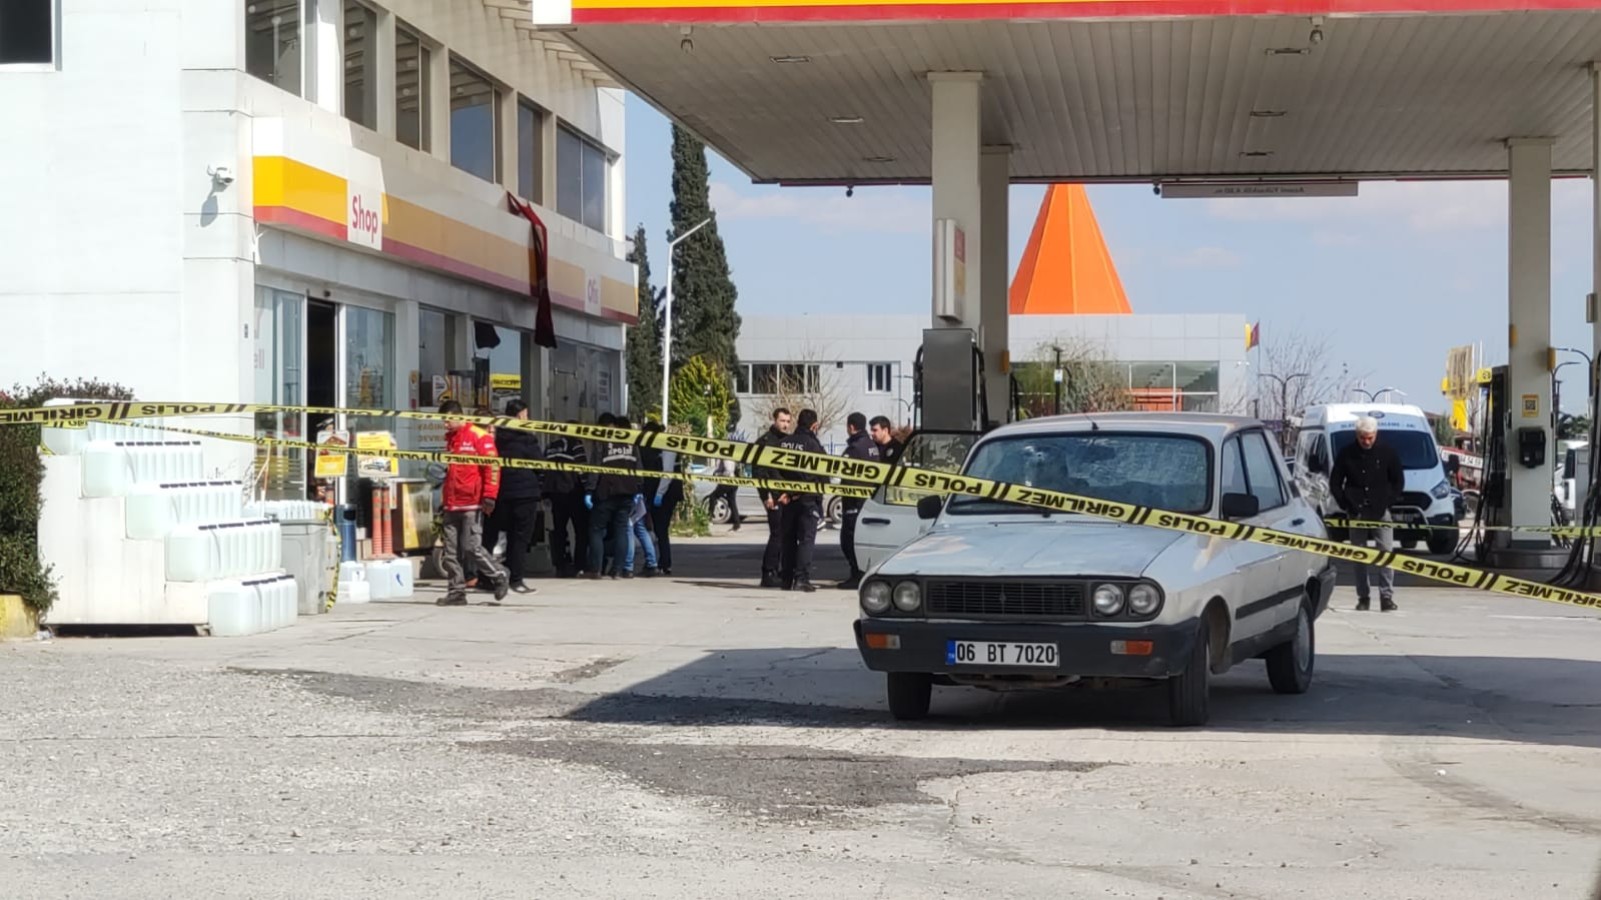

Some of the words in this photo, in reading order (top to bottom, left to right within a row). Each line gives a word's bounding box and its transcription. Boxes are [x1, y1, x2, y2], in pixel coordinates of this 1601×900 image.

[352, 193, 378, 244] Shop
[664, 436, 736, 457] POLİS
[770, 449, 881, 480] GİRİLMEZ
[956, 642, 976, 662] 06
[987, 643, 1007, 663] BT
[1014, 644, 1055, 664] 7020
